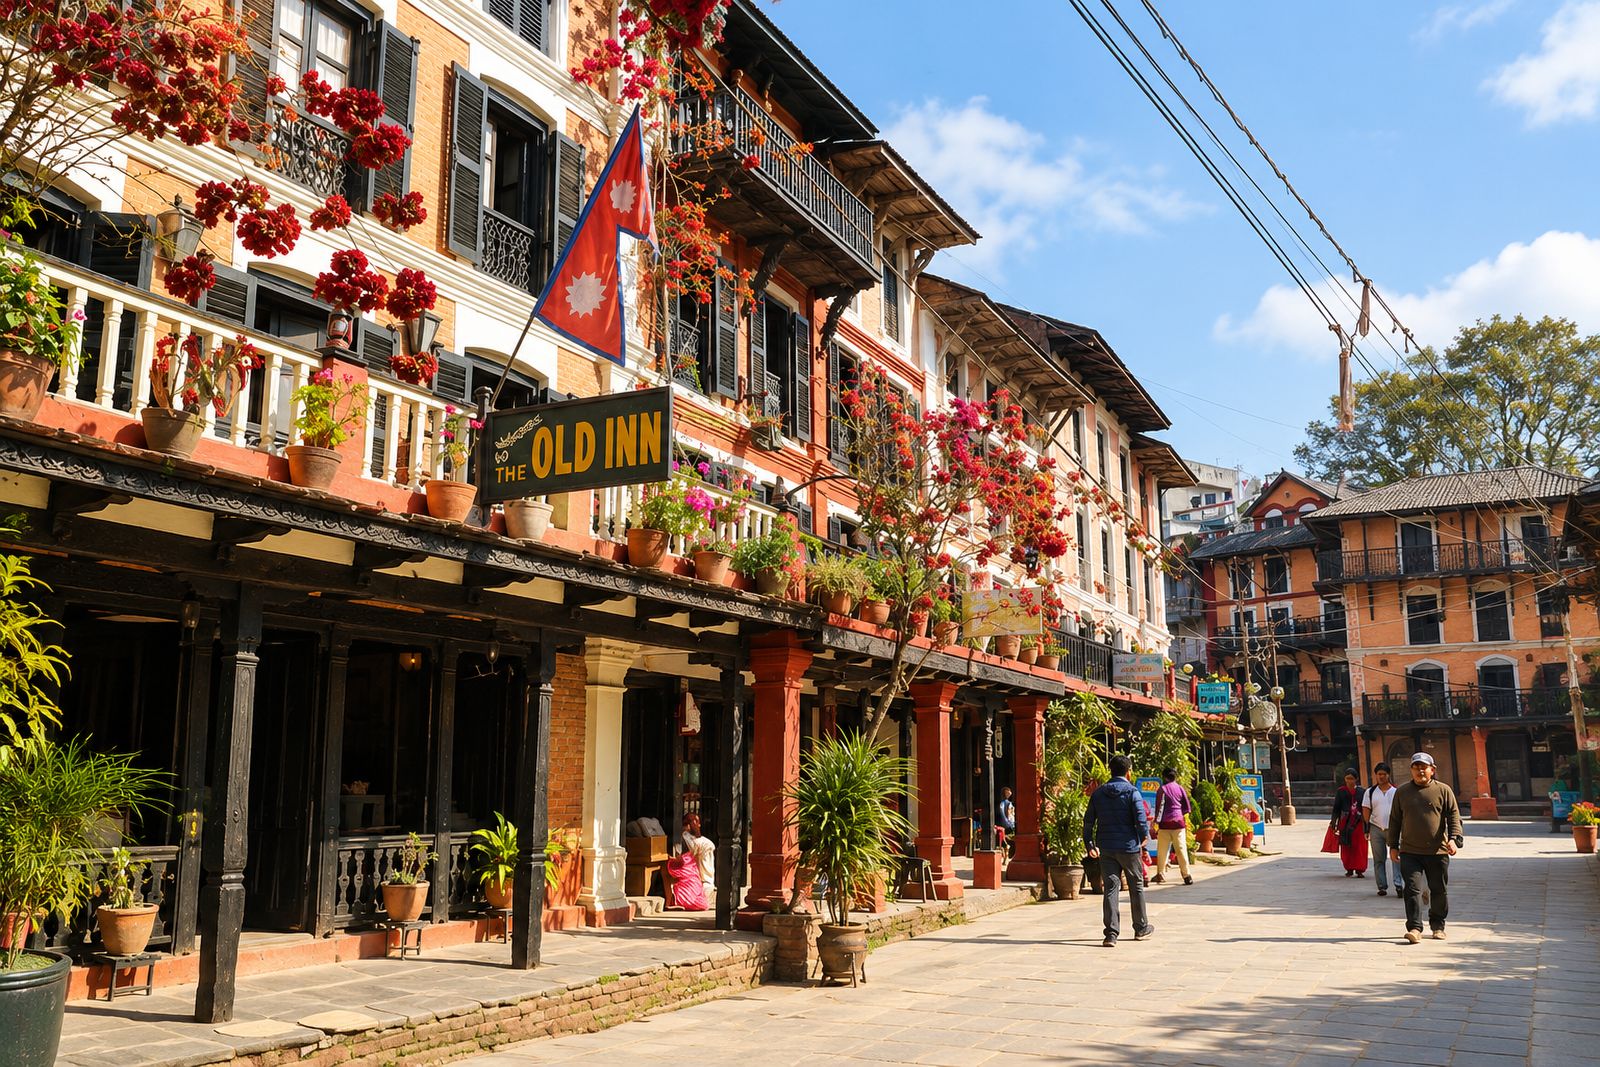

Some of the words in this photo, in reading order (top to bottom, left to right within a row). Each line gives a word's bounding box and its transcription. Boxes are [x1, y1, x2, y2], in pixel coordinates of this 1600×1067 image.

[495, 464, 527, 483] THE
[531, 421, 596, 479] OLD
[605, 411, 661, 469] INN
